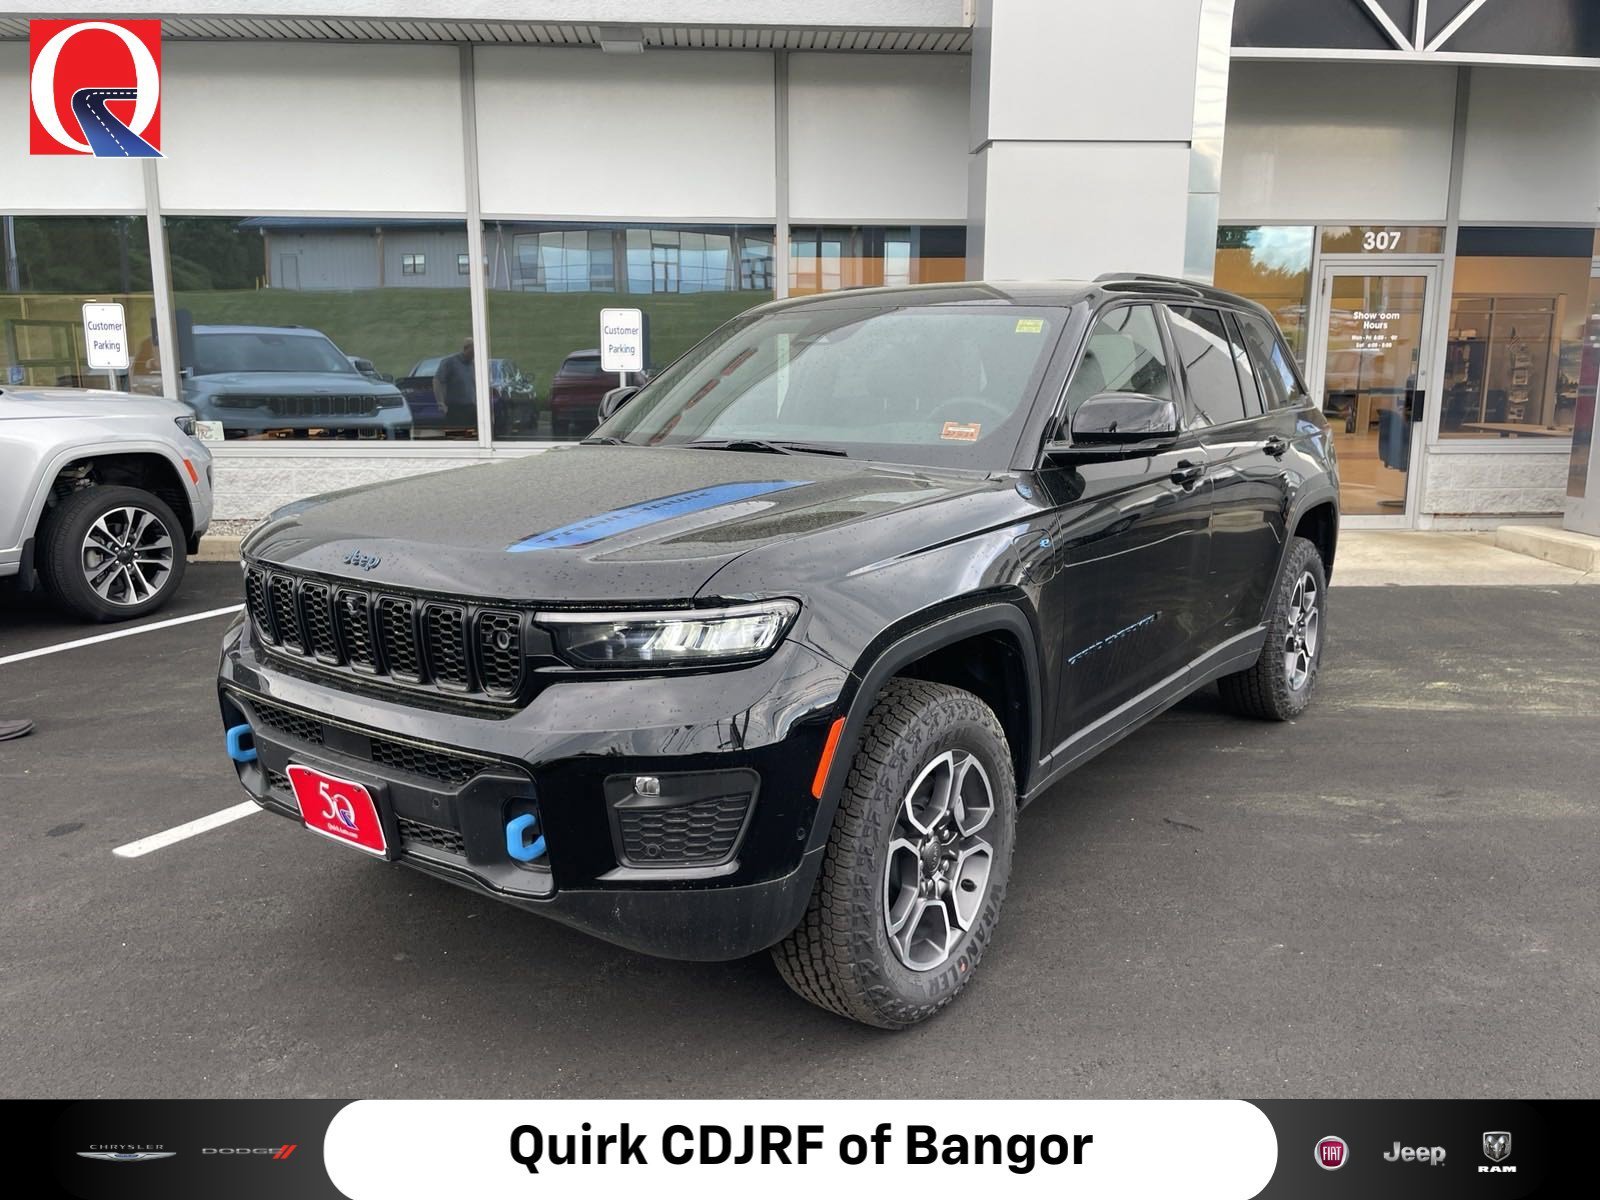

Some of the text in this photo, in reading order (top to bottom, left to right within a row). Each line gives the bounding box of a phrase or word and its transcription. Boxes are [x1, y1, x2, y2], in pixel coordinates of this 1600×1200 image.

[1364, 232, 1400, 249] 307
[1353, 311, 1400, 320] Showoom
[87, 320, 122, 331] Customer
[604, 325, 639, 335] Customer
[1363, 321, 1388, 329] Hours
[93, 340, 121, 352] Parking
[608, 344, 635, 356] Parking
[344, 547, 382, 572] Jeep
[928, 884, 1002, 998] WRANGLER
